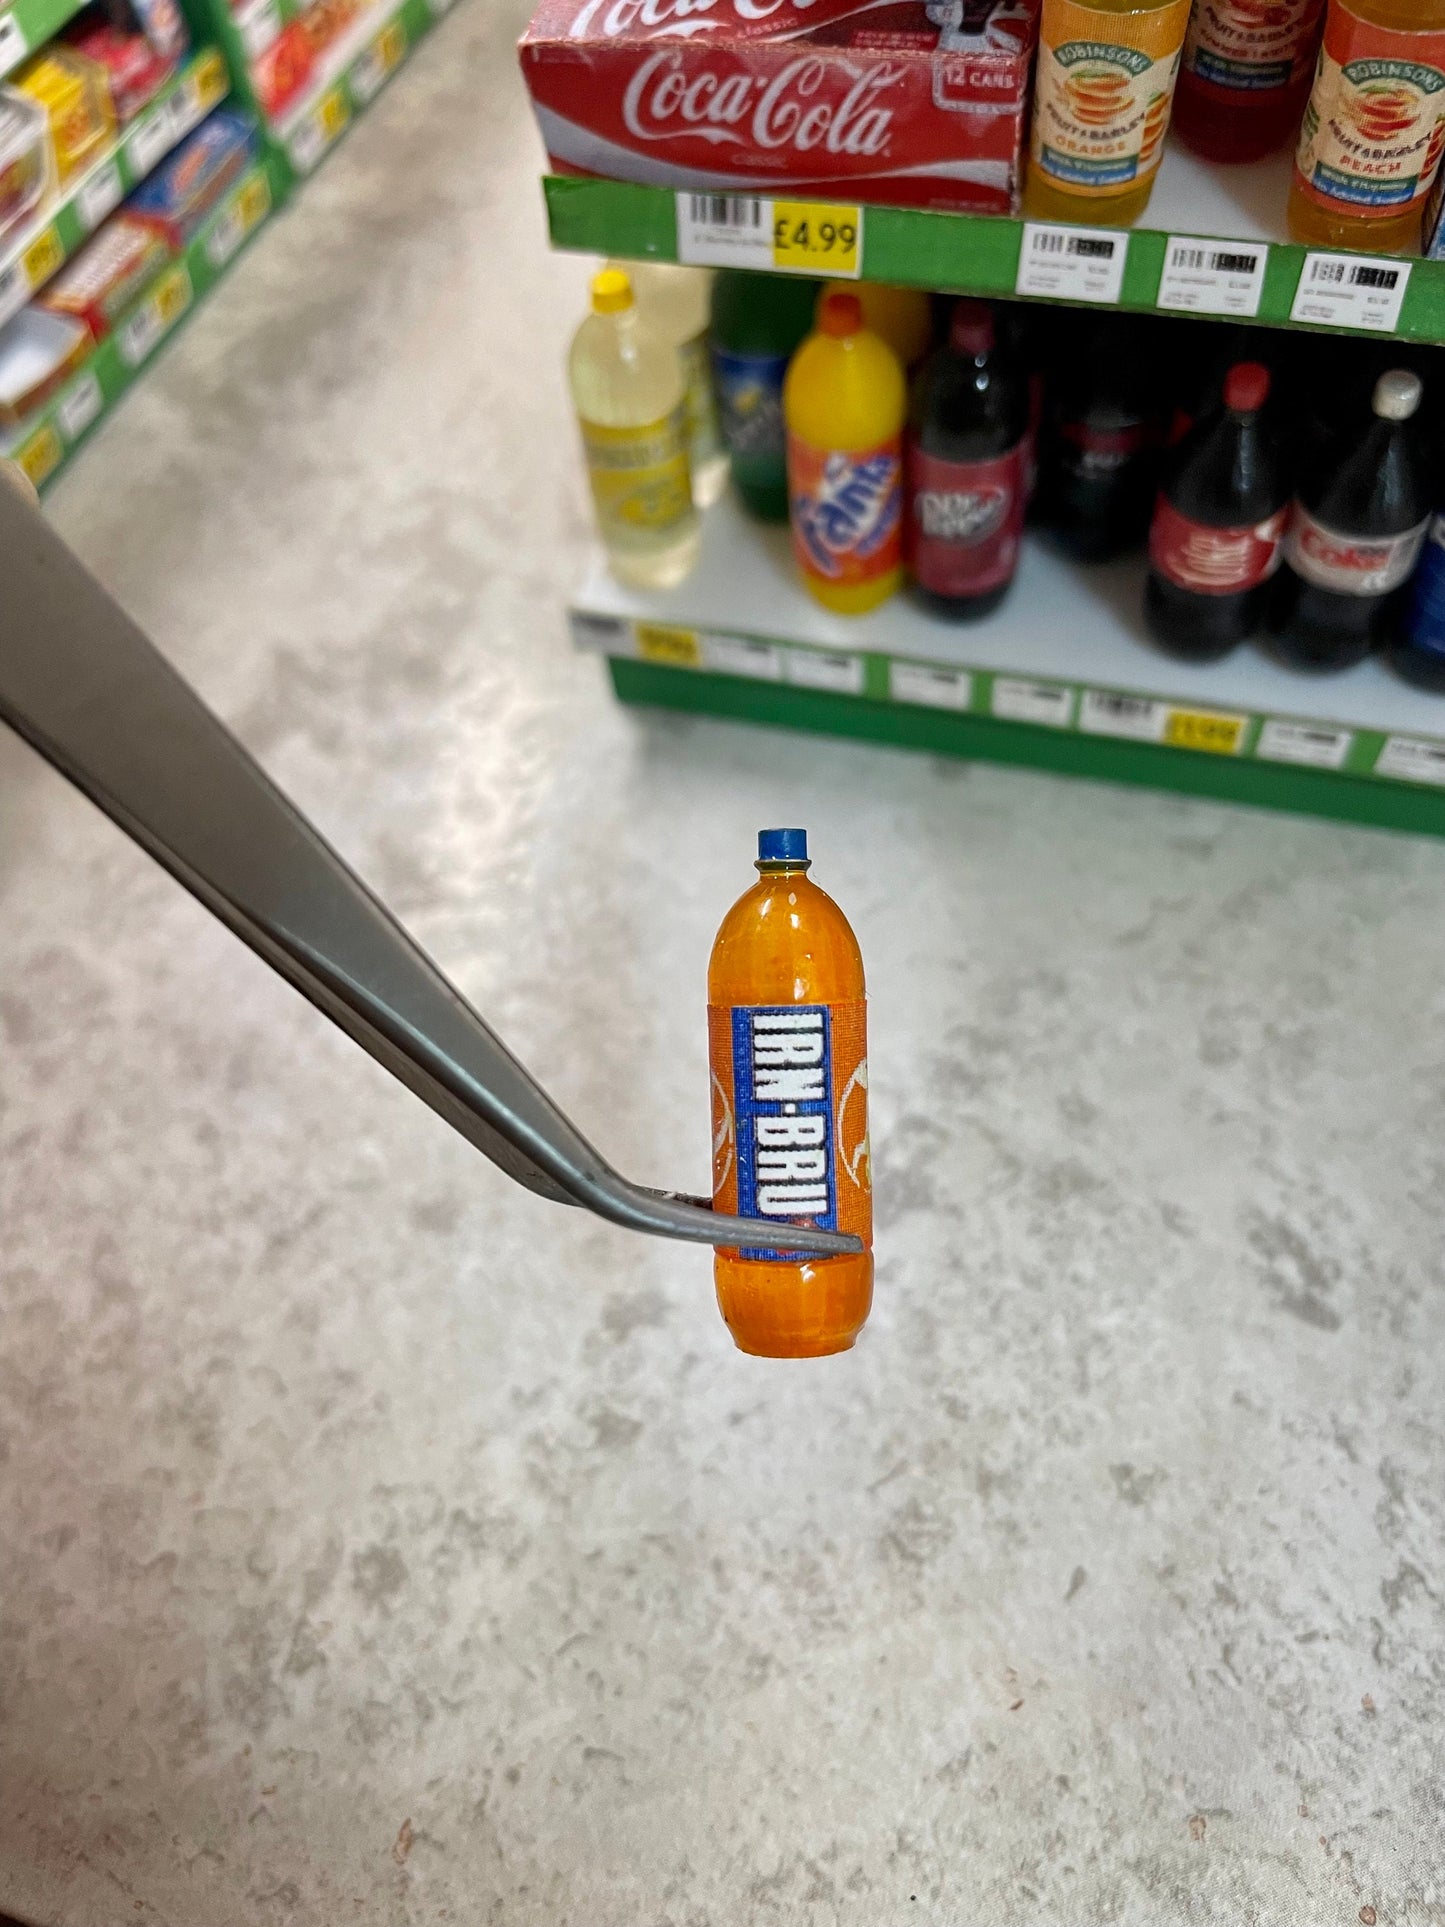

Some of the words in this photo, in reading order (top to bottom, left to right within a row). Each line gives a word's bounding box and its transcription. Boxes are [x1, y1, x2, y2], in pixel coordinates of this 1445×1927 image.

[1057, 44, 1147, 73] ROBINSONS
[944, 62, 966, 85] 12
[969, 72, 1015, 89] CANS
[1347, 62, 1443, 92] ROBINSONS
[1056, 135, 1126, 154] ORANGE
[1339, 155, 1402, 175] PEACH
[774, 218, 857, 255] £4.99
[751, 1011, 830, 1216] IRN-BRU
